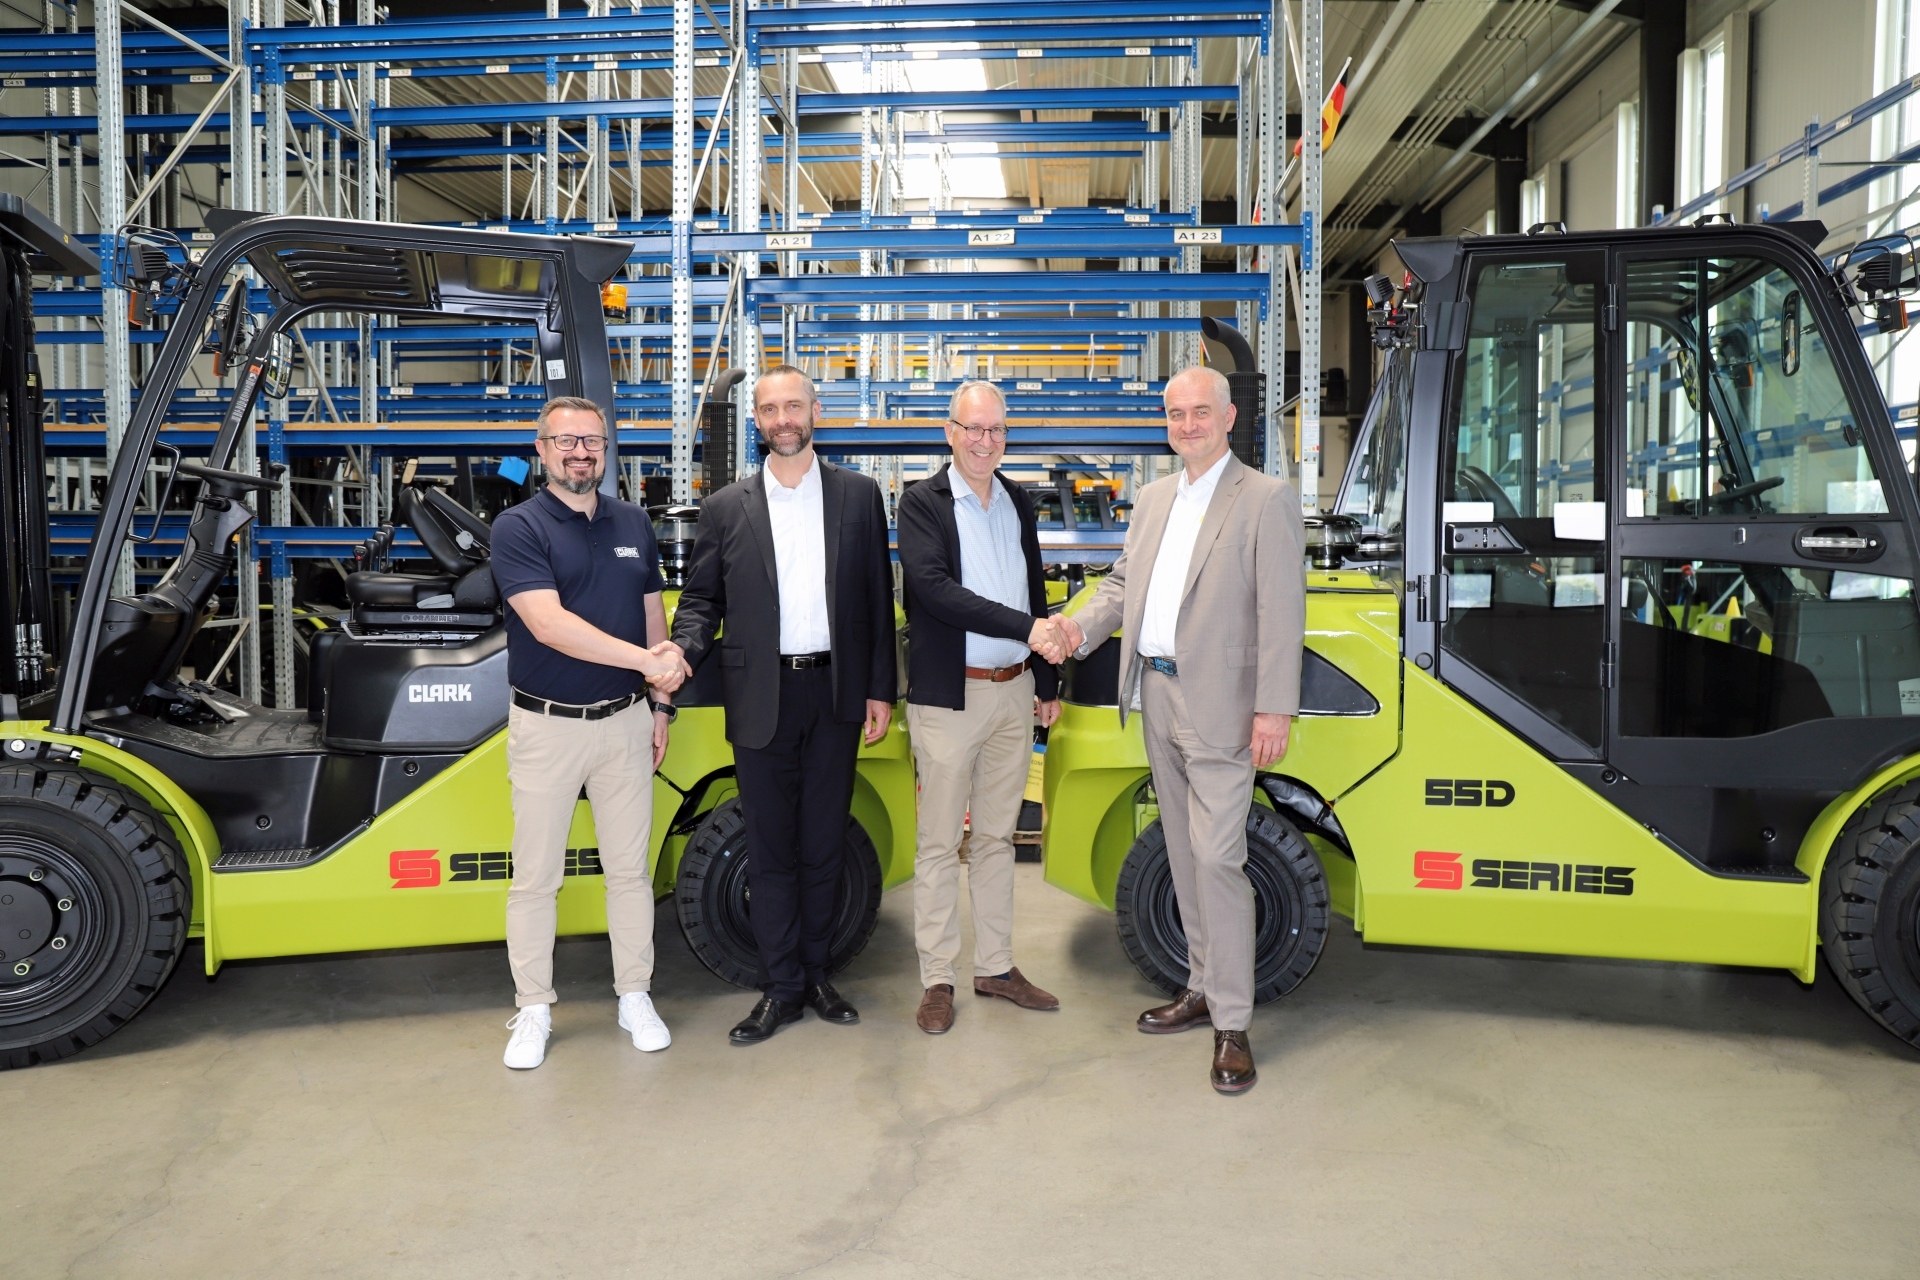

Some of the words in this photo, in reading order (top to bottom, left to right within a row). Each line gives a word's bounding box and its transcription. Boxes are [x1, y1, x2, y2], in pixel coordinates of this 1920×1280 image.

[793, 237, 806, 245] 21
[995, 233, 1010, 241] 22
[615, 547, 639, 558] CLARK
[412, 614, 460, 622] GRAMMER
[408, 684, 472, 702] CLARK
[1470, 858, 1637, 895] SERIES
